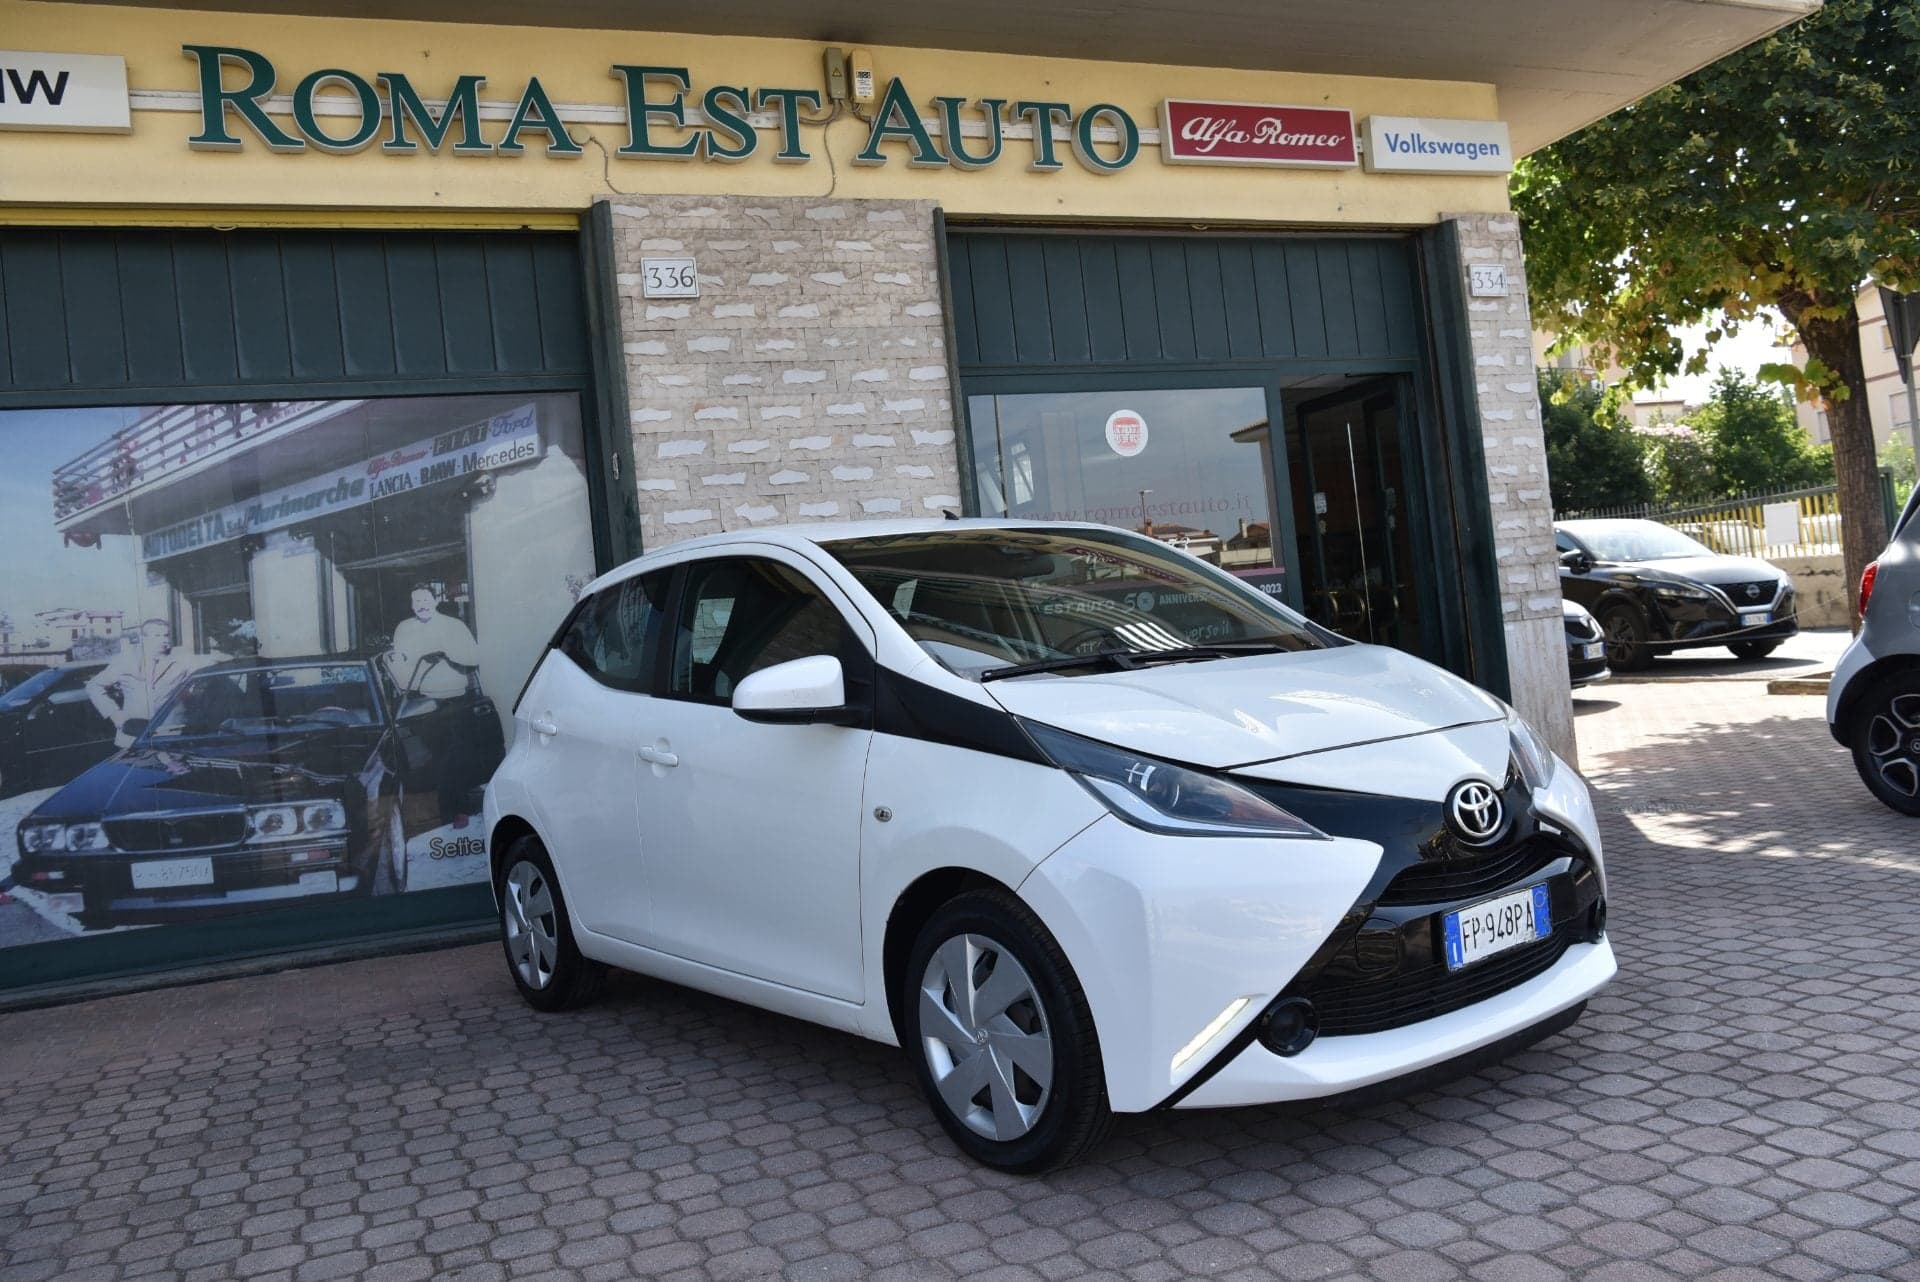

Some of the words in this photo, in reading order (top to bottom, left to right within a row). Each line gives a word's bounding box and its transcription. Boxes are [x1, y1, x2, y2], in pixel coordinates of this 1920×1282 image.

[1181, 116, 1250, 153] Alfa
[1252, 117, 1346, 147] Romeo
[1384, 132, 1500, 160] Volkswagen
[648, 265, 694, 289] 336
[1474, 271, 1504, 289] 334
[437, 424, 486, 450] FIAT
[491, 408, 534, 438] Ford
[369, 471, 413, 499] LANCIA
[420, 457, 456, 484] BMW
[462, 440, 535, 473] Mercedes
[429, 836, 486, 860] Sette
